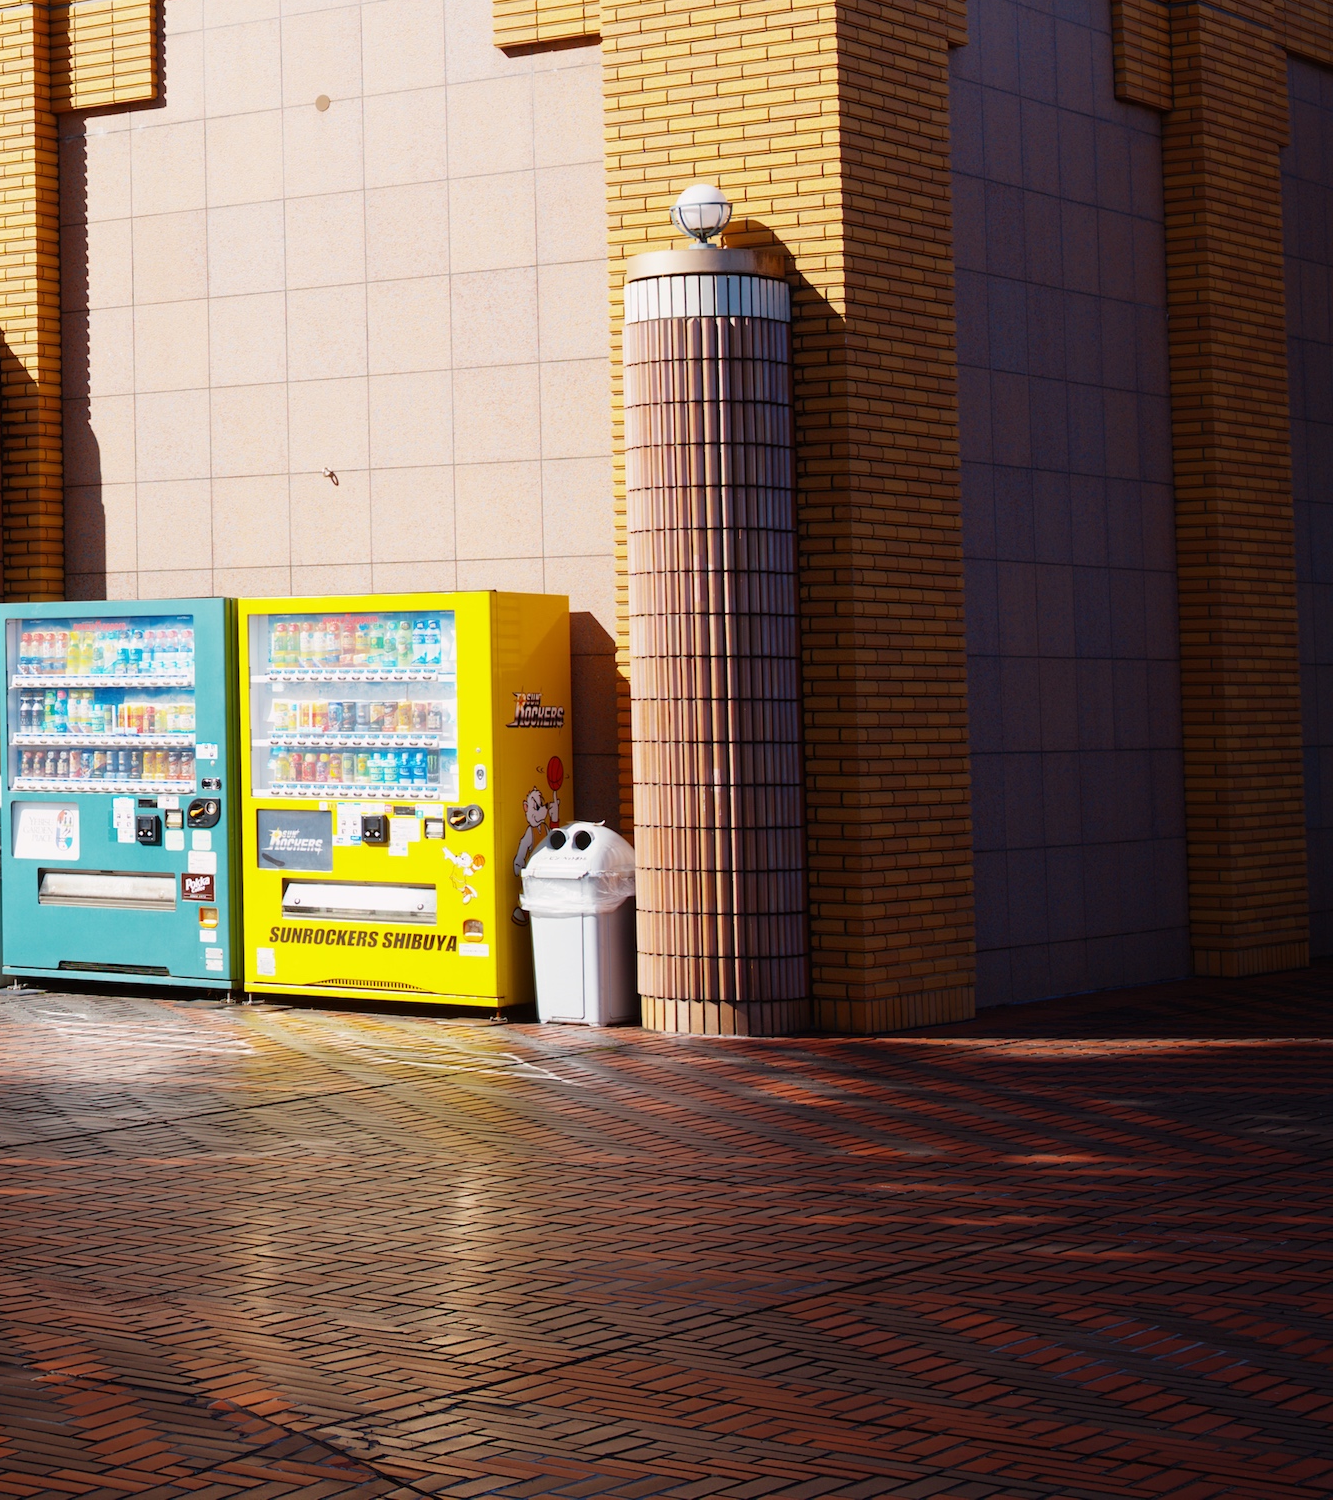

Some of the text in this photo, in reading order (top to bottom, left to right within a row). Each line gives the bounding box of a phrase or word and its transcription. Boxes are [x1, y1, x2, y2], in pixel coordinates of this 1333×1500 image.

[505, 692, 565, 729] ROCKERS
[261, 829, 324, 856] ROCKERS
[281, 829, 301, 839] SUN
[185, 876, 211, 891] Pokka
[269, 926, 458, 952] SUNROCKERS SHIBUYA
